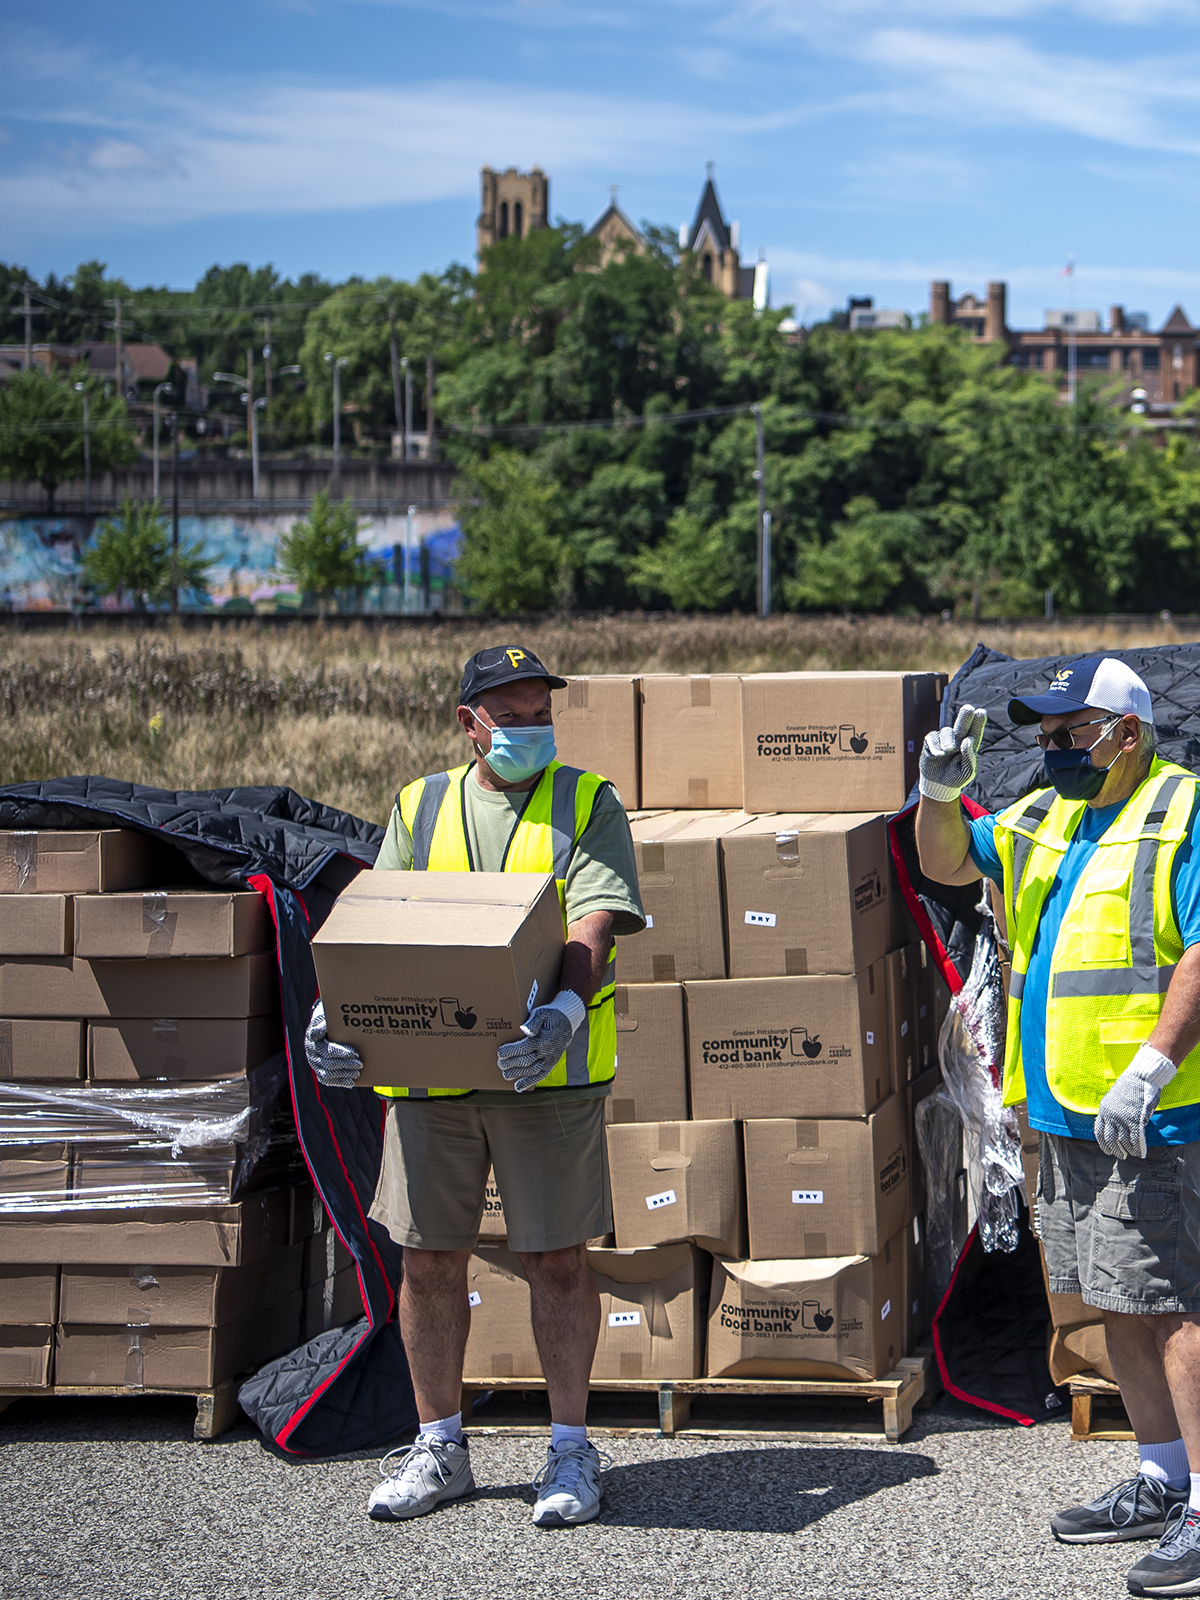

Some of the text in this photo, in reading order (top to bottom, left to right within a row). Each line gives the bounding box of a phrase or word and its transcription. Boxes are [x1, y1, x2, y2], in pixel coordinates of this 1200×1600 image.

[506, 649, 525, 668] P
[756, 731, 838, 744] community
[757, 744, 831, 756] food bank
[340, 1002, 438, 1018] community
[343, 1015, 433, 1030] food bank
[702, 1035, 788, 1050] community
[703, 1048, 782, 1064] food bank
[766, 1059, 838, 1068] pittsburghfoodbank.org
[653, 1196, 670, 1206] DRY
[721, 1303, 800, 1321] community
[720, 1314, 793, 1332] food bank
